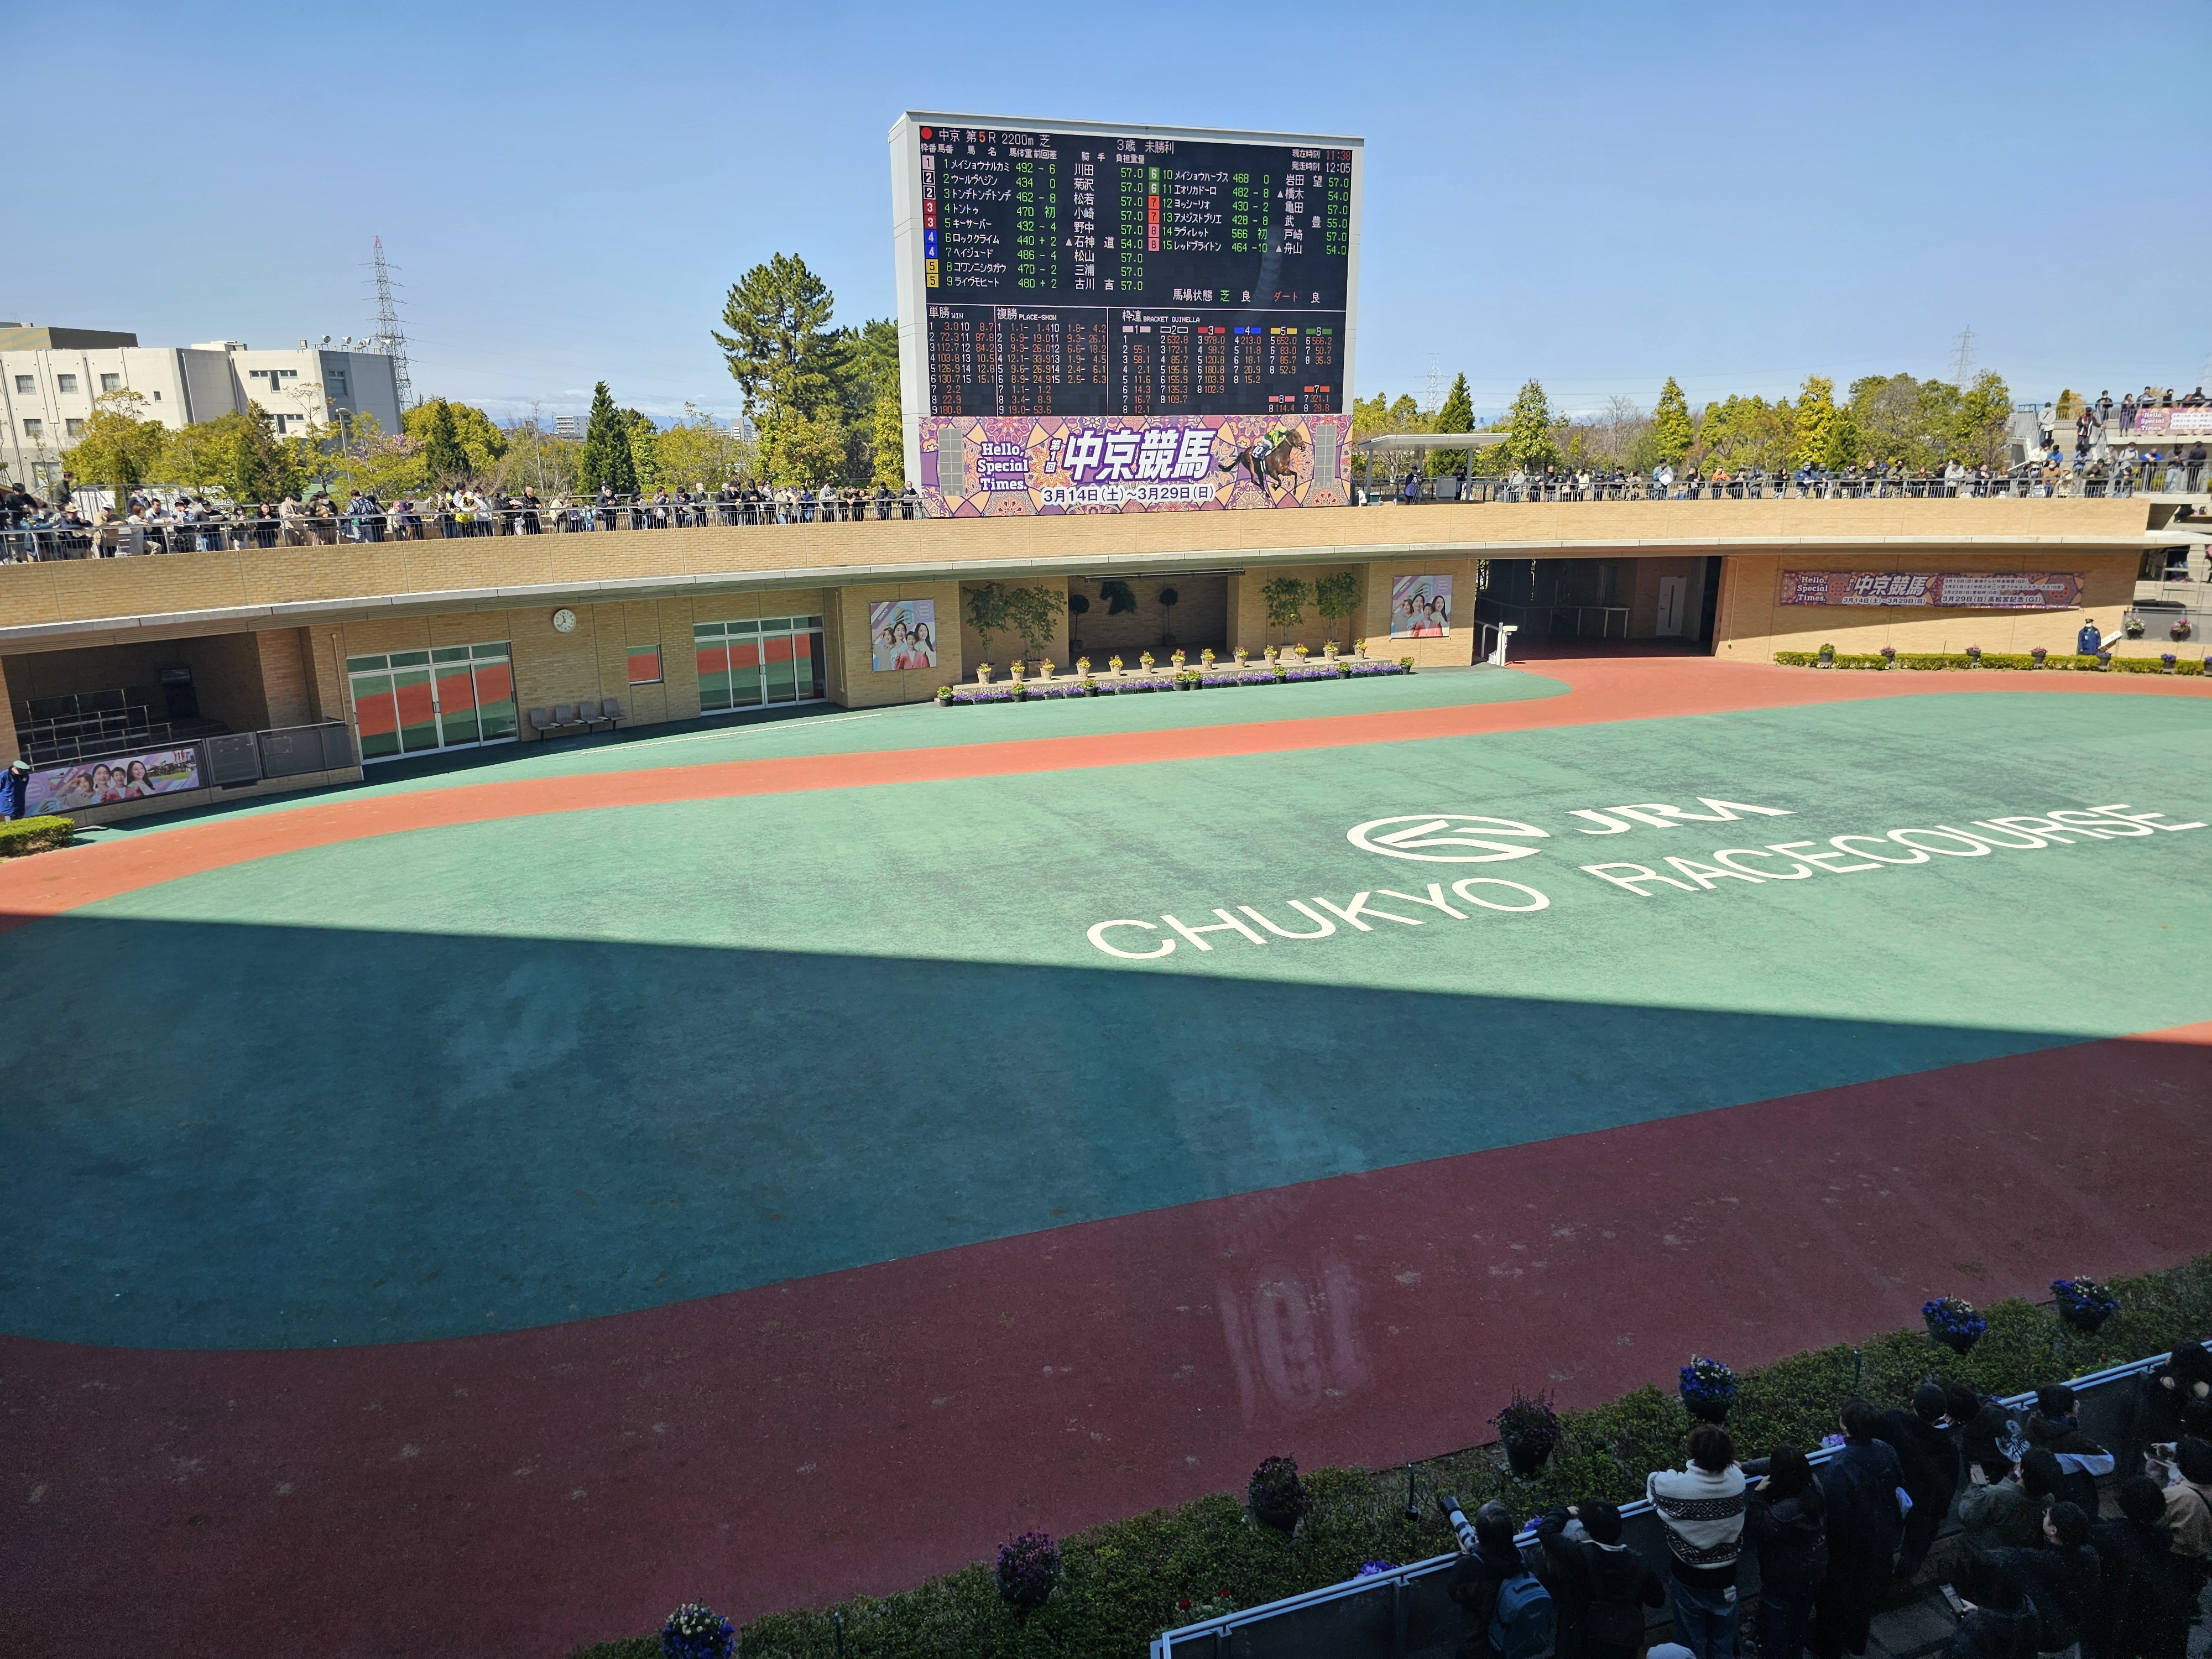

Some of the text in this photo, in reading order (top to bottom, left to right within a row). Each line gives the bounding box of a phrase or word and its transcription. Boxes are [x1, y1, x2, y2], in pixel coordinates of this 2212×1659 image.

[940, 128, 960, 142] 中京
[1002, 133, 1034, 145] 2200m
[1040, 134, 1050, 147] 芝
[1117, 139, 1135, 152] 3歳
[1145, 140, 1173, 154] 未勝利
[921, 143, 936, 153] 枠番
[937, 144, 953, 154] 馬番
[1009, 148, 1032, 158] 馬体重
[1034, 149, 1057, 159] 前回差
[1116, 154, 1144, 164] 負担重量
[1292, 149, 1350, 160] 現在時刻 11:38
[945, 159, 1142, 178] 1 メイショウナルカミ 492 川田 57.0
[1292, 161, 1350, 173] 発走時刻 12:05
[943, 174, 949, 183] 2
[1016, 178, 1032, 187] 434
[1073, 178, 1094, 191] 菊沢
[1121, 182, 1142, 192] 57.0
[1164, 170, 1172, 179] 10
[1233, 174, 1249, 183] 468
[1286, 174, 1304, 186] 岩田
[1313, 175, 1322, 187] 望
[1329, 178, 1348, 187] 57.0
[944, 188, 1142, 206] 3 トンデトンデトンデ 462 松若 57.0
[1164, 184, 1171, 194] 11
[1233, 187, 1248, 197] 482
[1328, 191, 1348, 201] 54.0
[945, 204, 1142, 221] 4 トントゥ 470 小崎 57.0
[1164, 199, 1172, 208] 12
[1175, 199, 1210, 210] ヨッシーリオ
[1233, 201, 1248, 211] 430
[1328, 205, 1347, 215] 57.0
[945, 218, 1142, 234] 5 キーサーバー 432 野中 57.0
[1163, 213, 1172, 222] 13
[1232, 215, 1248, 225] 428
[1285, 215, 1294, 227] 武
[1327, 218, 1347, 228] 55.0
[1163, 226, 1347, 241] 14 ラヴィレット 566 戸崎 57.0
[946, 233, 951, 242] 6
[1018, 236, 1034, 245] 440
[1074, 236, 1094, 248] 石神
[1104, 237, 1114, 248] 道
[1121, 239, 1142, 249] 54.0
[1163, 241, 1172, 249] 15
[1232, 243, 1247, 252] 464
[1284, 242, 1302, 254] 舟山
[1327, 246, 1346, 254] 54.0
[946, 247, 1142, 263] 7 ヘイジュード 486 松山 57.0
[947, 262, 952, 272] 8
[1018, 264, 1035, 274] 470
[1074, 264, 1094, 276] 三浦
[1121, 267, 1142, 276] 57.0
[947, 276, 1142, 290] 9 ライヴモヒート 480 古川 吉 57.0
[1173, 289, 1320, 303] 馬場状態 芝 良 ダート 良
[928, 306, 950, 319] 単勝
[997, 307, 1017, 320] 複勝
[1123, 310, 1142, 322] 枠連
[945, 322, 994, 331] 3.0 8.7
[940, 332, 994, 342] 72.3 87.8
[937, 343, 994, 352] 112.7 84.2
[937, 353, 994, 363] 103.8 10.5
[937, 364, 994, 373] 126.9 12.8
[938, 374, 994, 383] 130.7 15.1
[946, 385, 961, 394] 2.2
[942, 395, 961, 404] 22.9
[939, 405, 962, 414] 180.8
[982, 443, 1024, 457] Hello,
[1063, 429, 1216, 481] 中京競馬
[978, 459, 1029, 474] Special
[980, 478, 1027, 491] Times.
[1043, 486, 1214, 503] 3月14日(土)～3月29日(日)
[1802, 576, 1826, 585] Hello,
[1854, 575, 1929, 596] 中京競馬
[1797, 585, 1828, 593] Special
[1564, 798, 1797, 836] JRA
[1580, 803, 2207, 897] RACECOURSE
[1087, 878, 1550, 961] CHUKYO
